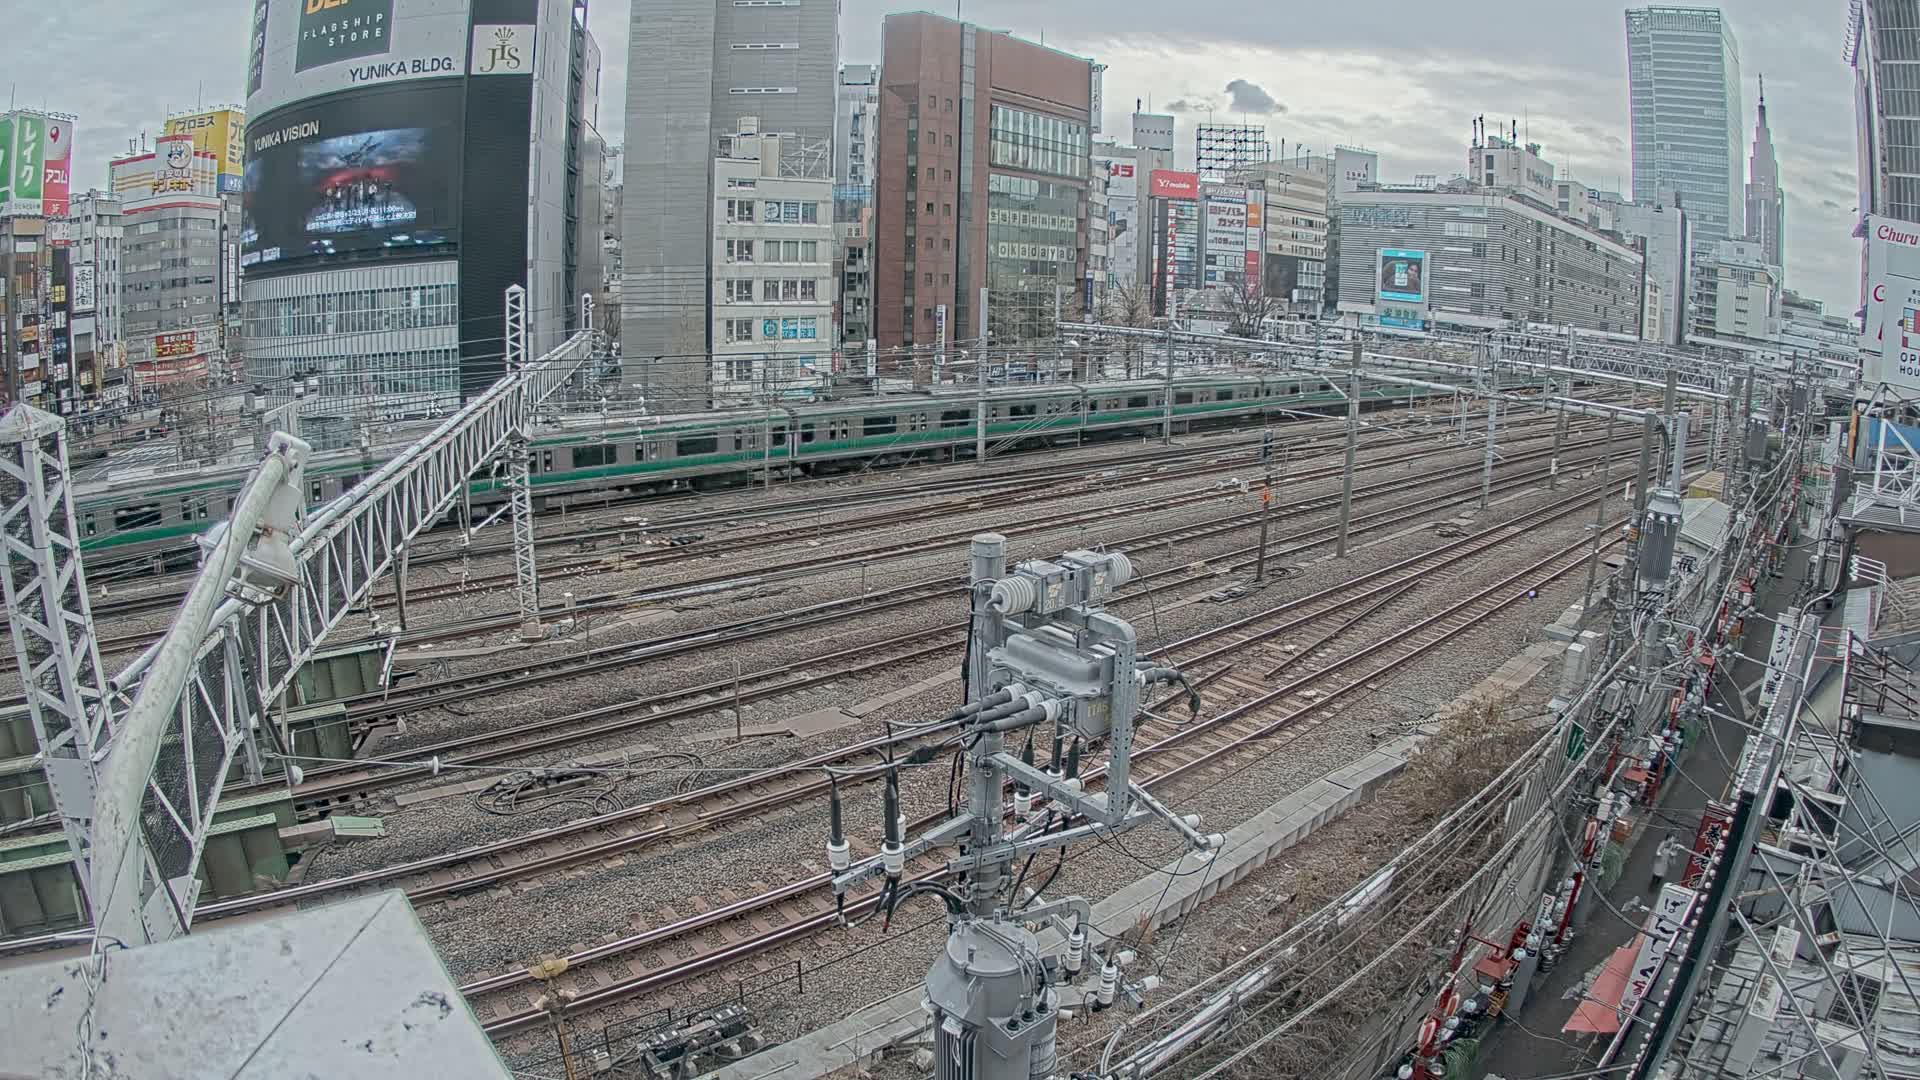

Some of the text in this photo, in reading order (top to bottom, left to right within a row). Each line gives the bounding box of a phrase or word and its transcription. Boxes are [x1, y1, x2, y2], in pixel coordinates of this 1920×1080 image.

[303, 13, 384, 40] FLAGSHIP
[328, 27, 383, 47] STORE
[350, 56, 456, 82] YUNIKA BLDG.
[175, 115, 215, 133] プロミス
[253, 129, 283, 153] YUNIKA
[282, 119, 320, 142] VISION
[20, 120, 37, 187] レイク
[45, 168, 68, 184] アコム
[1877, 224, 1919, 246] Churu
